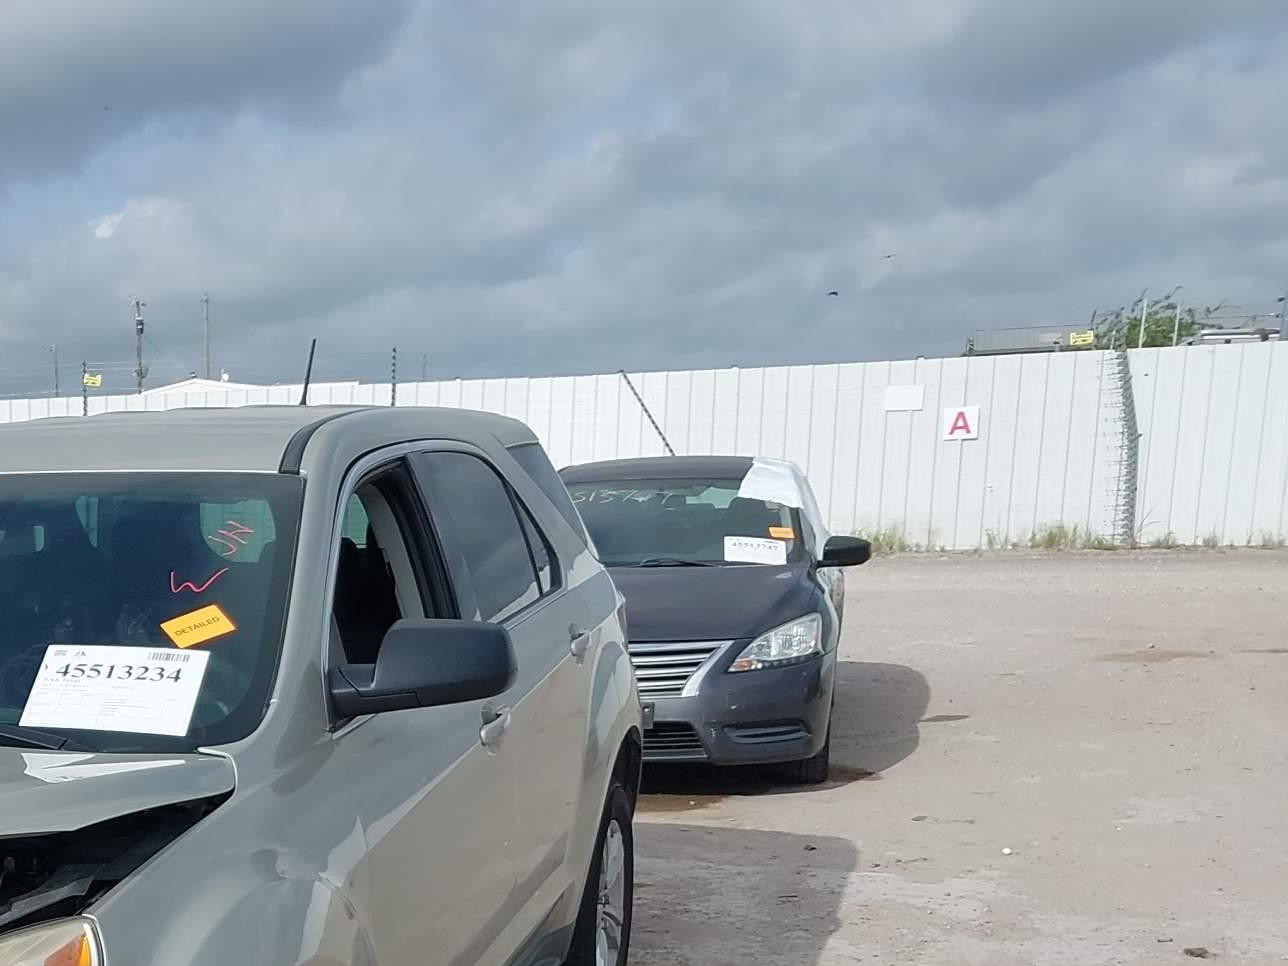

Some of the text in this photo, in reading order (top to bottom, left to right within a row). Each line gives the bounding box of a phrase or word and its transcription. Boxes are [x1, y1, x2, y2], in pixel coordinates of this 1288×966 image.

[948, 411, 971, 435] A
[173, 615, 221, 637] DETAILED
[55, 662, 183, 684] 45513234
